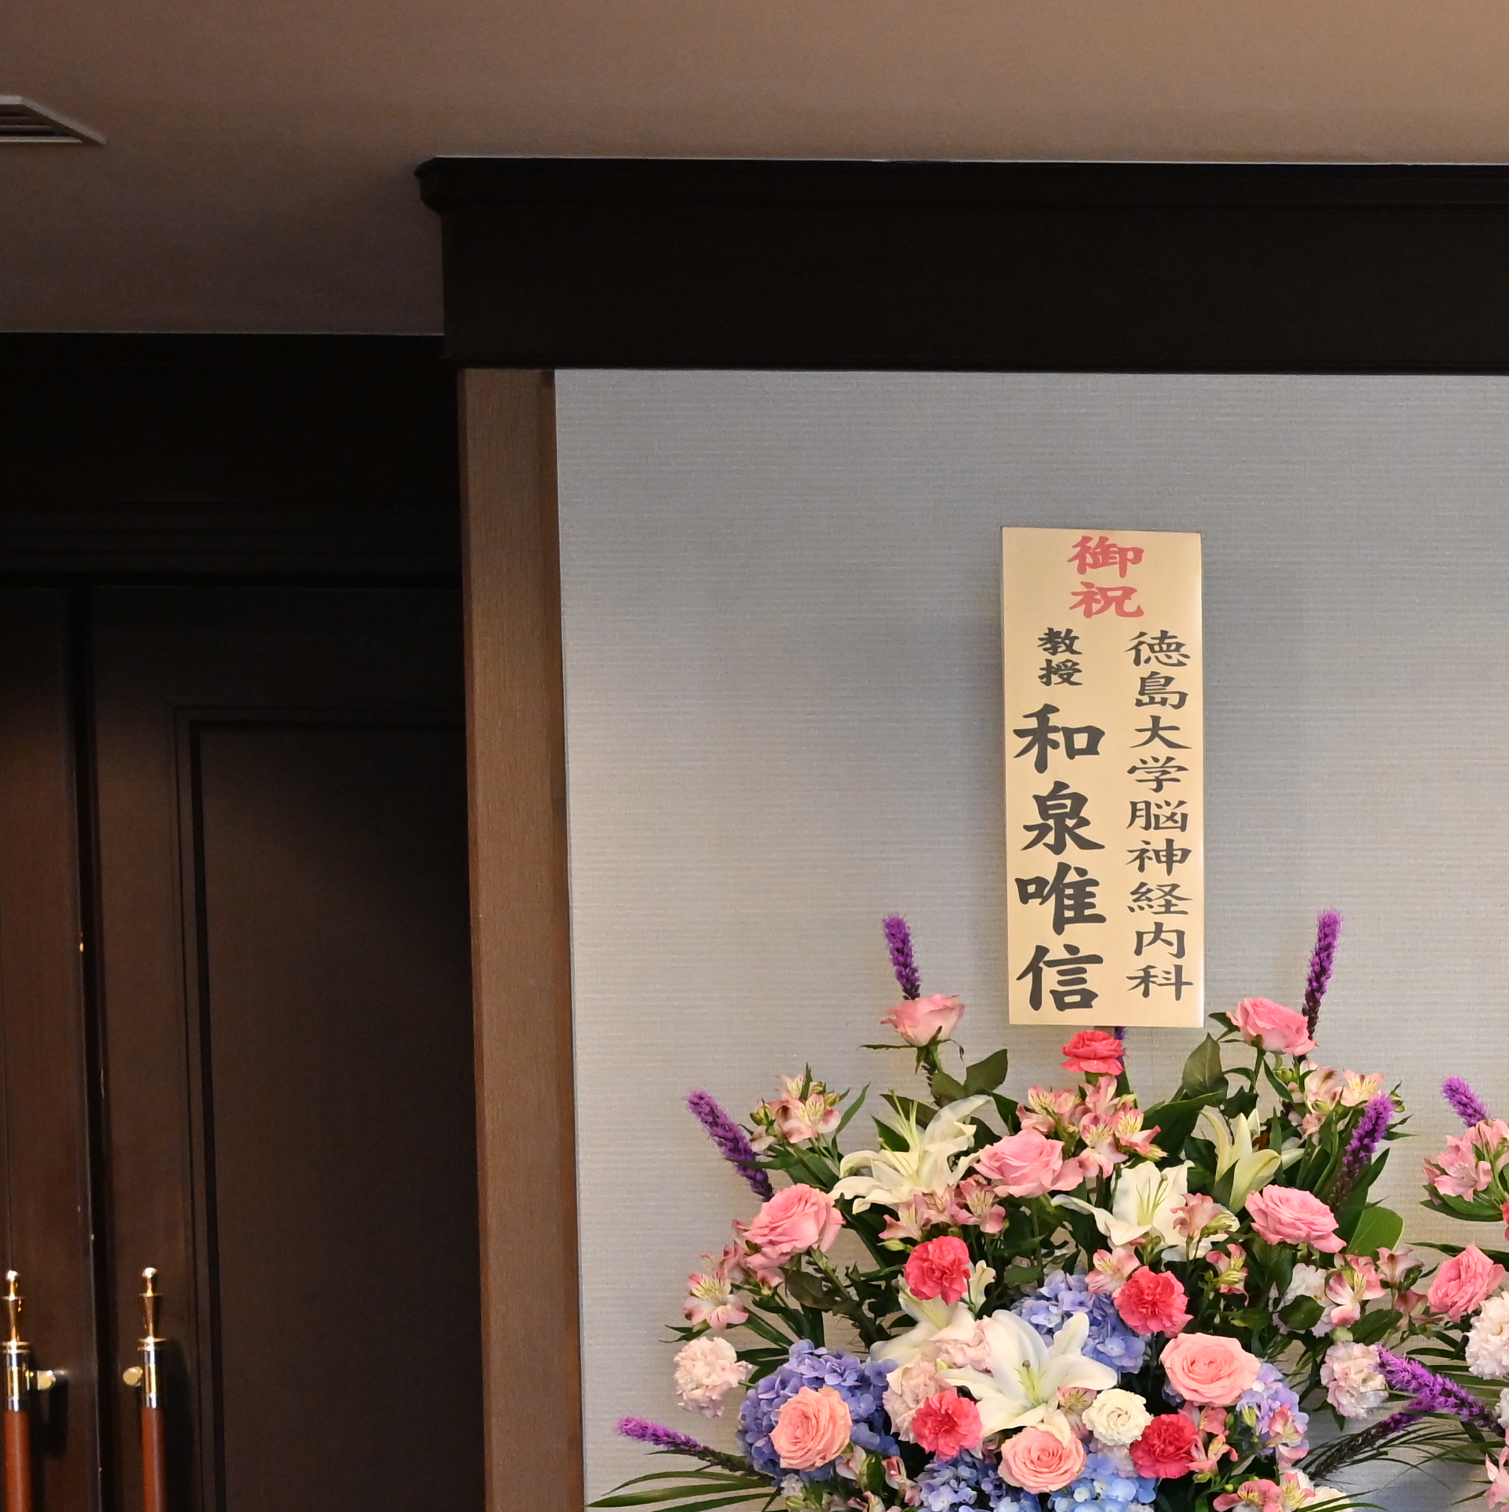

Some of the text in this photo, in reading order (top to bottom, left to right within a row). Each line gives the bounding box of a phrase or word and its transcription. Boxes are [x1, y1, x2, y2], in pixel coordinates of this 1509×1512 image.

[1066, 535, 1145, 619] 御祝
[1012, 626, 1107, 1012] 教授 和泉唯信
[1124, 629, 1194, 1002] 徳島大学脳神経内科
